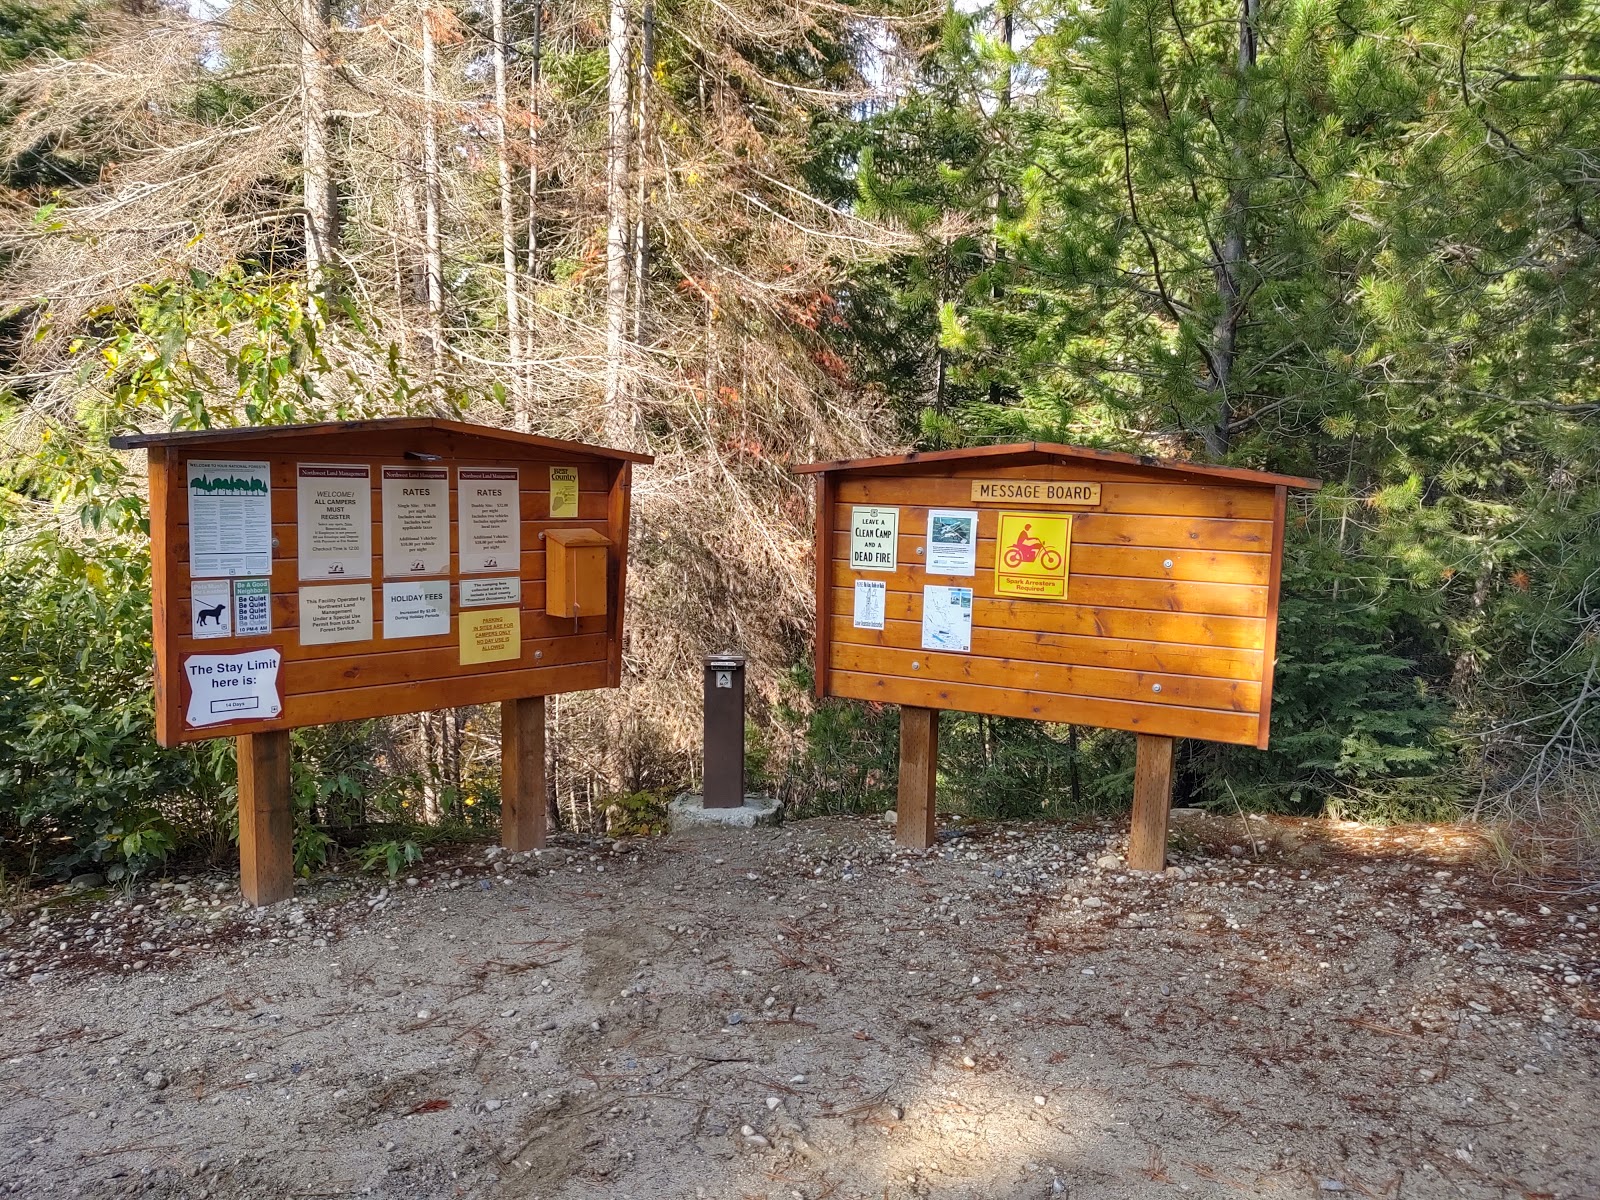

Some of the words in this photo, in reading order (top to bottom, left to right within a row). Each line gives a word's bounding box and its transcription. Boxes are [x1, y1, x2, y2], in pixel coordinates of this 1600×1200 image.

[552, 474, 576, 482] Country
[980, 484, 1040, 498] MESSAGE
[1046, 486, 1092, 500] BOARD
[855, 552, 873, 562] DEAD
[876, 552, 891, 563] FIRE
[190, 666, 212, 675] The
[217, 663, 243, 674] Stay
[247, 659, 276, 670] Limit
[212, 679, 238, 688] here
[242, 676, 256, 685] is:
